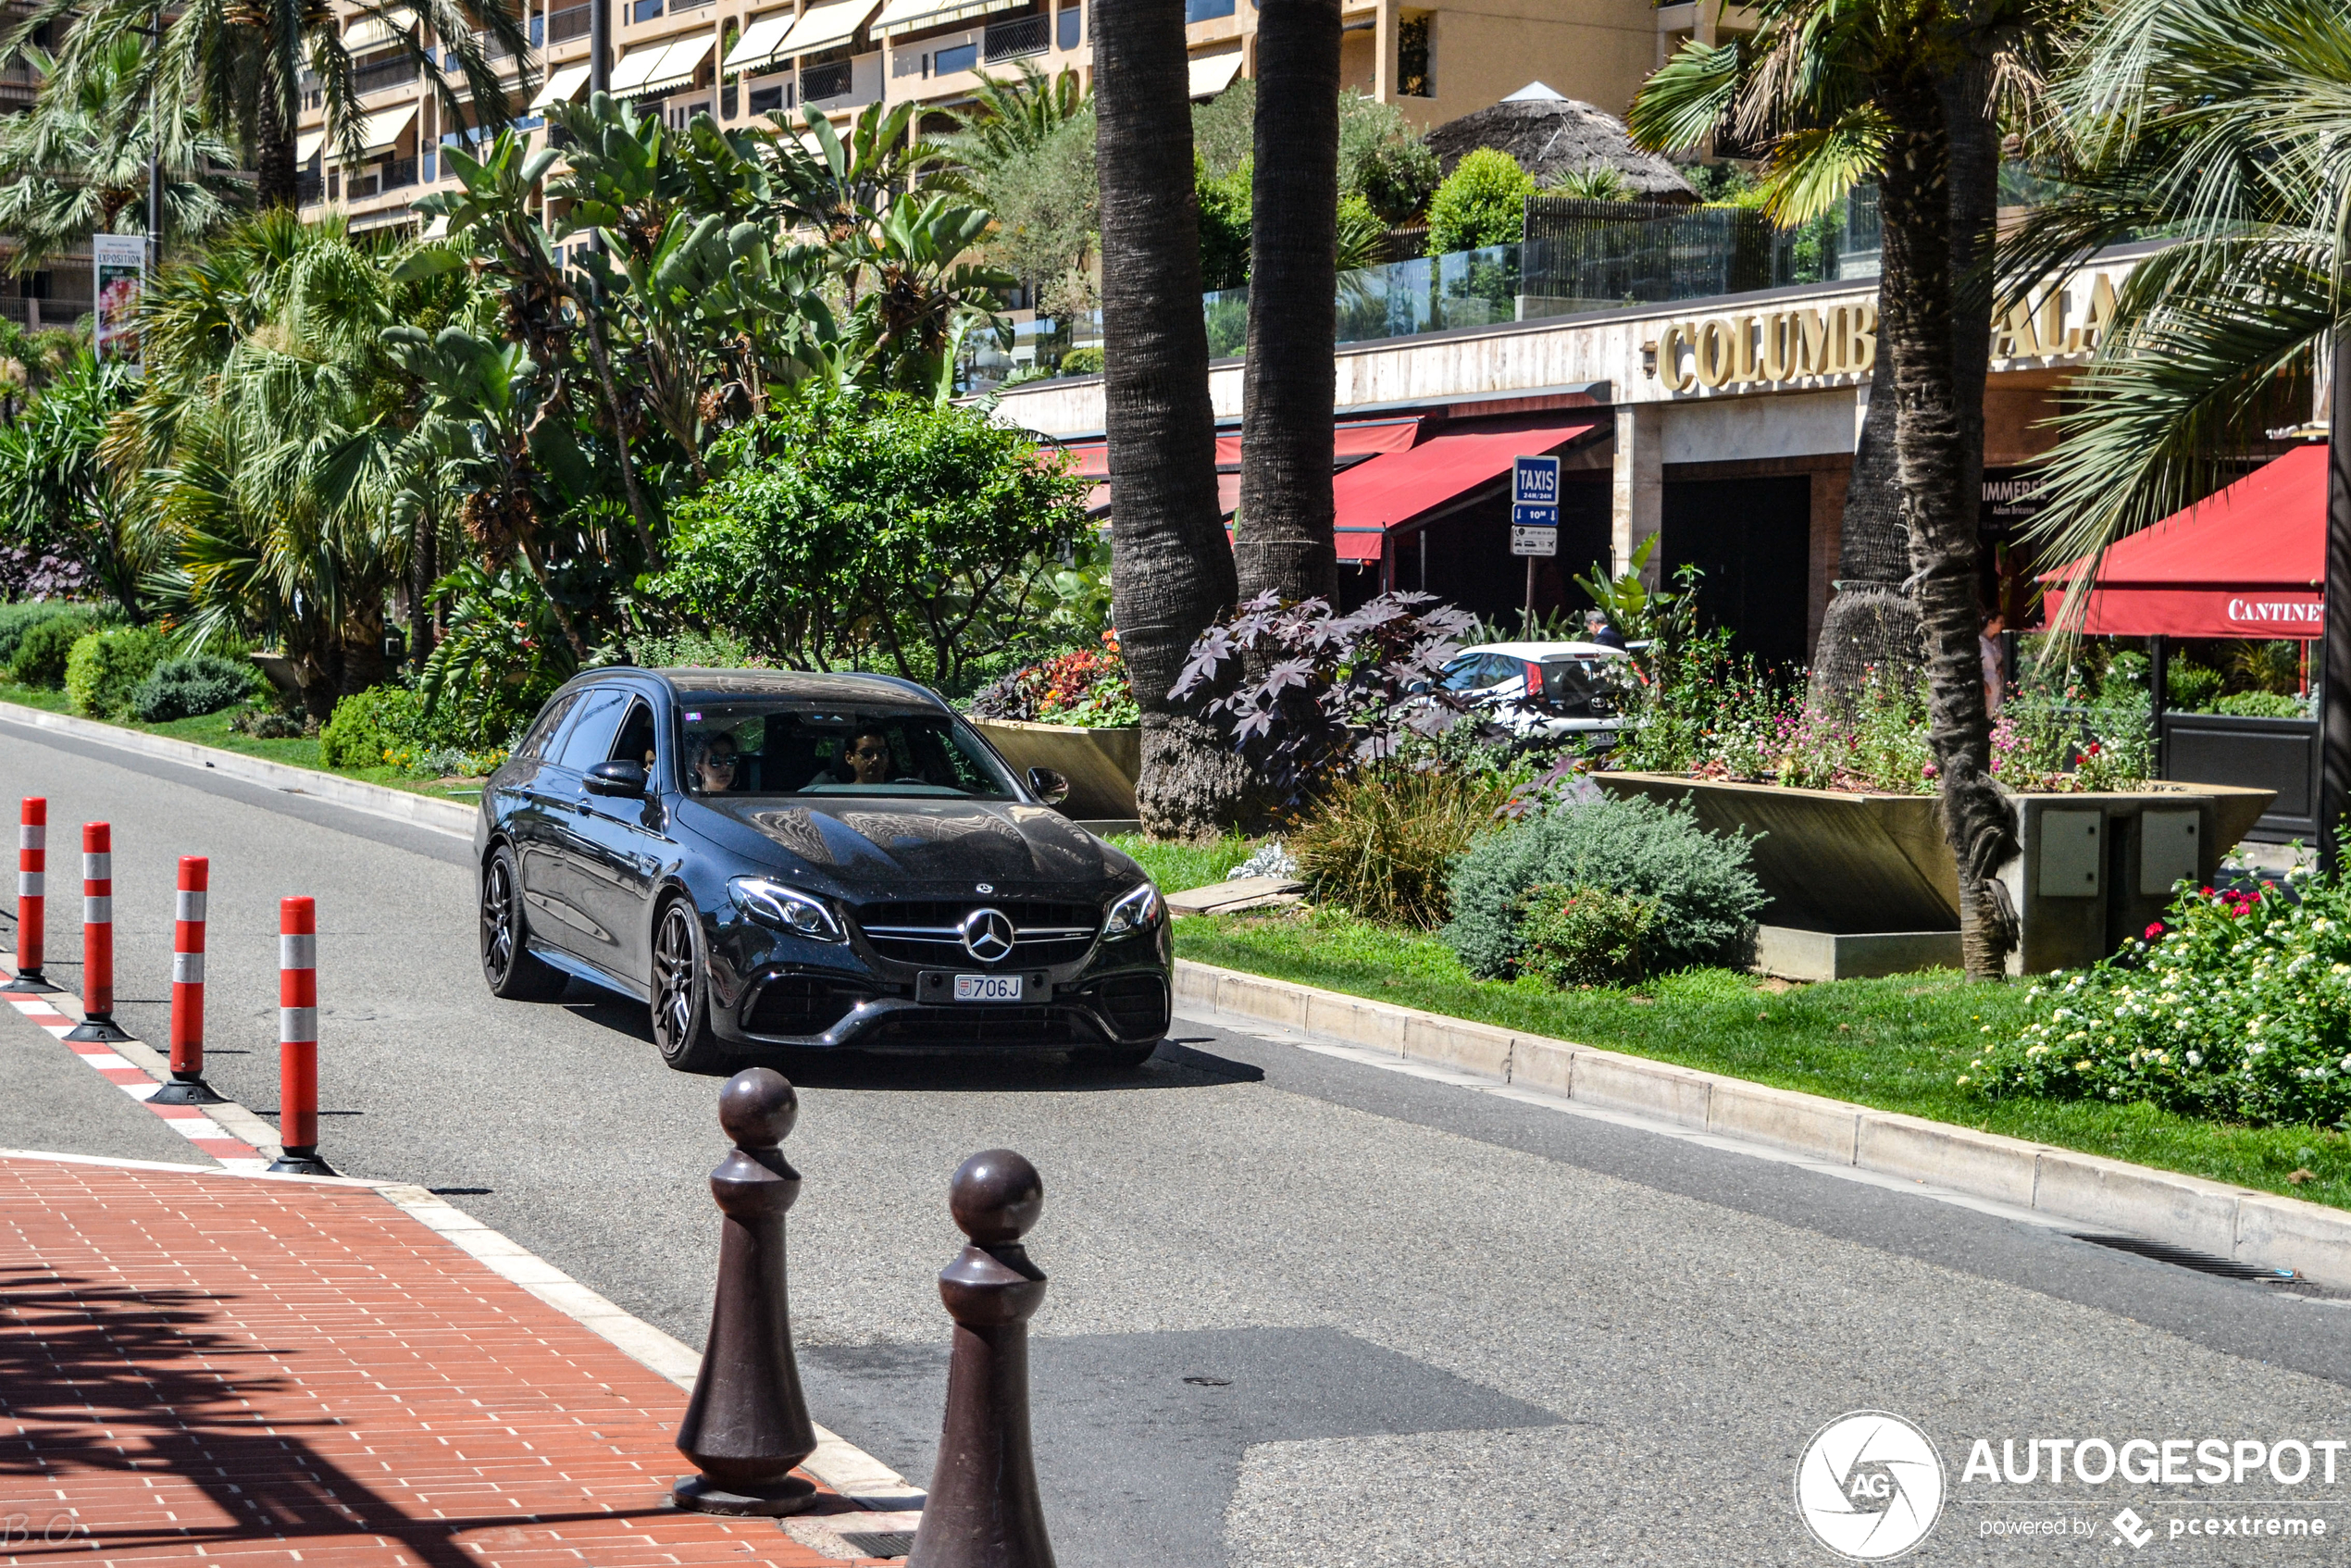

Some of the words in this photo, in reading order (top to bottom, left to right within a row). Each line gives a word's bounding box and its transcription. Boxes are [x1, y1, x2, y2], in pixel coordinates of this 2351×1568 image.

[98, 253, 142, 264] EXPOSITION
[1519, 469, 1554, 492] TAXIS
[1523, 492, 1552, 500] 24H/24H
[1992, 504, 2010, 516] Adam
[2011, 504, 2035, 515] Bricusse
[2228, 598, 2324, 622] CANTINE
[974, 979, 1019, 997] 706J
